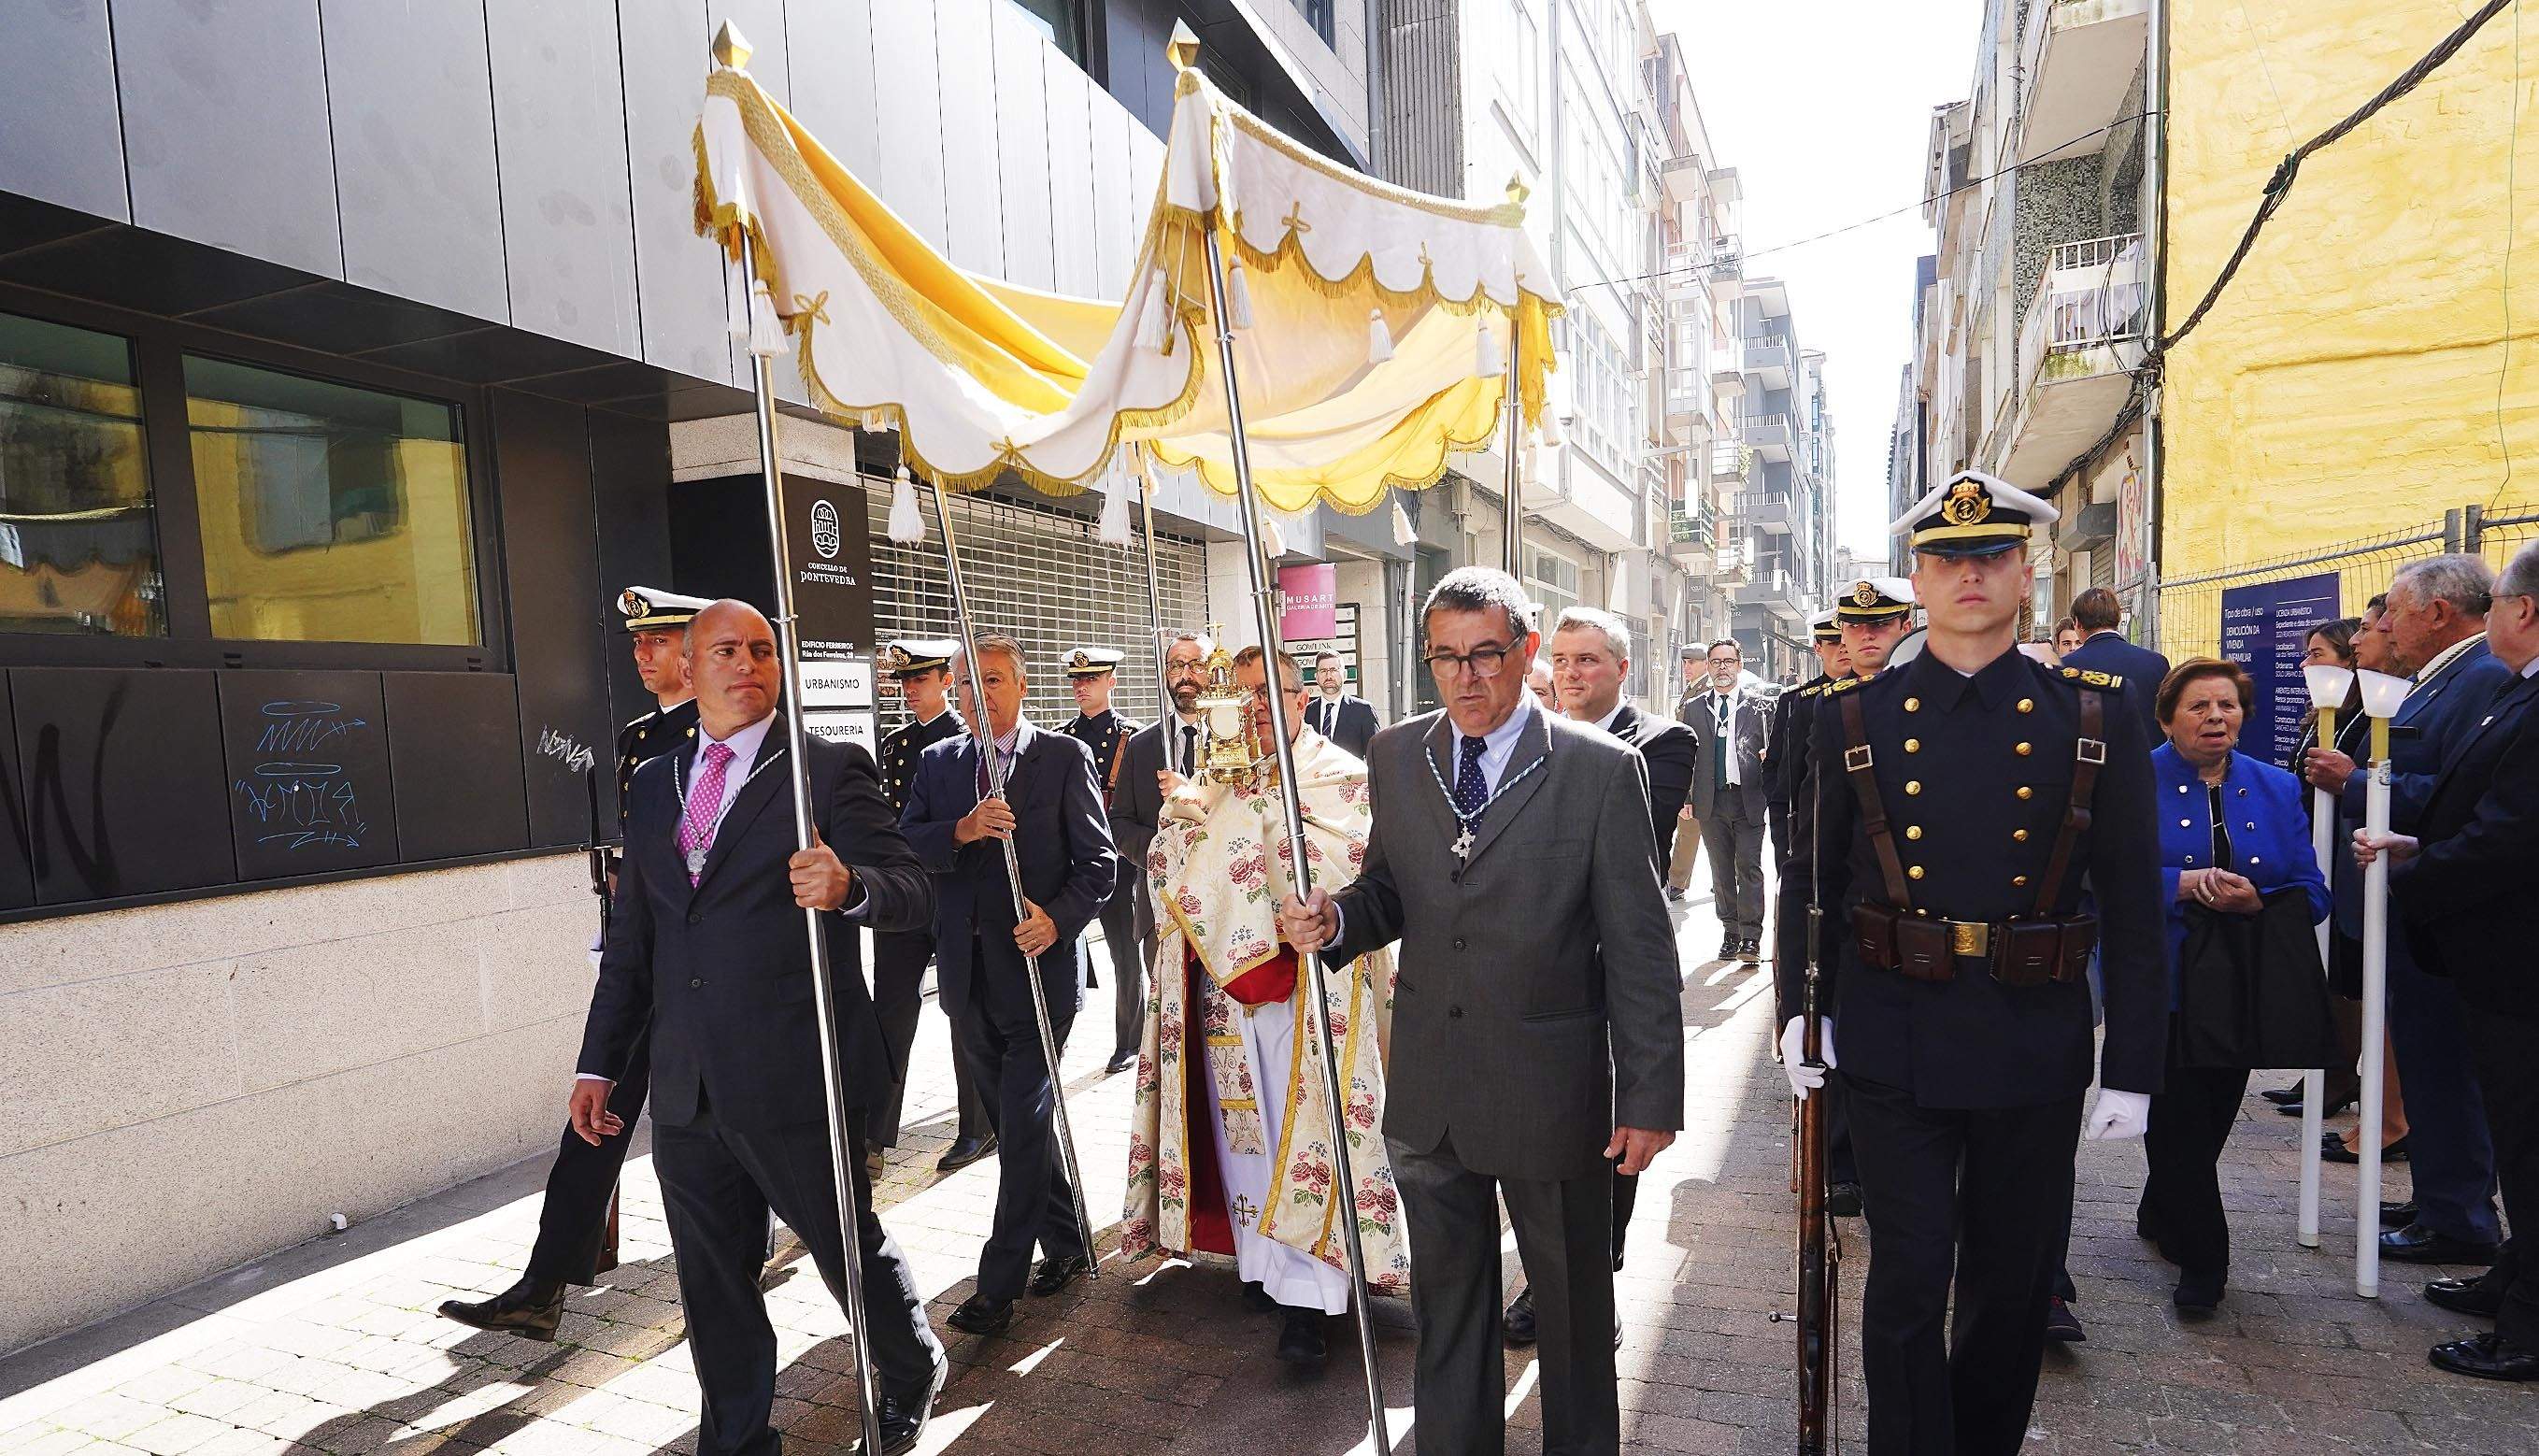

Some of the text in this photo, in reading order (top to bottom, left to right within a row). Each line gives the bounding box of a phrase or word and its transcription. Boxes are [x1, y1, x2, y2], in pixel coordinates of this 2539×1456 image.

[807, 562, 838, 572] CONCELLO
[800, 571, 857, 585] PONTEVEDRA
[1286, 594, 1334, 604] MUSART
[801, 640, 825, 649] EDIFICIO
[805, 678, 860, 689] URBANISMO
